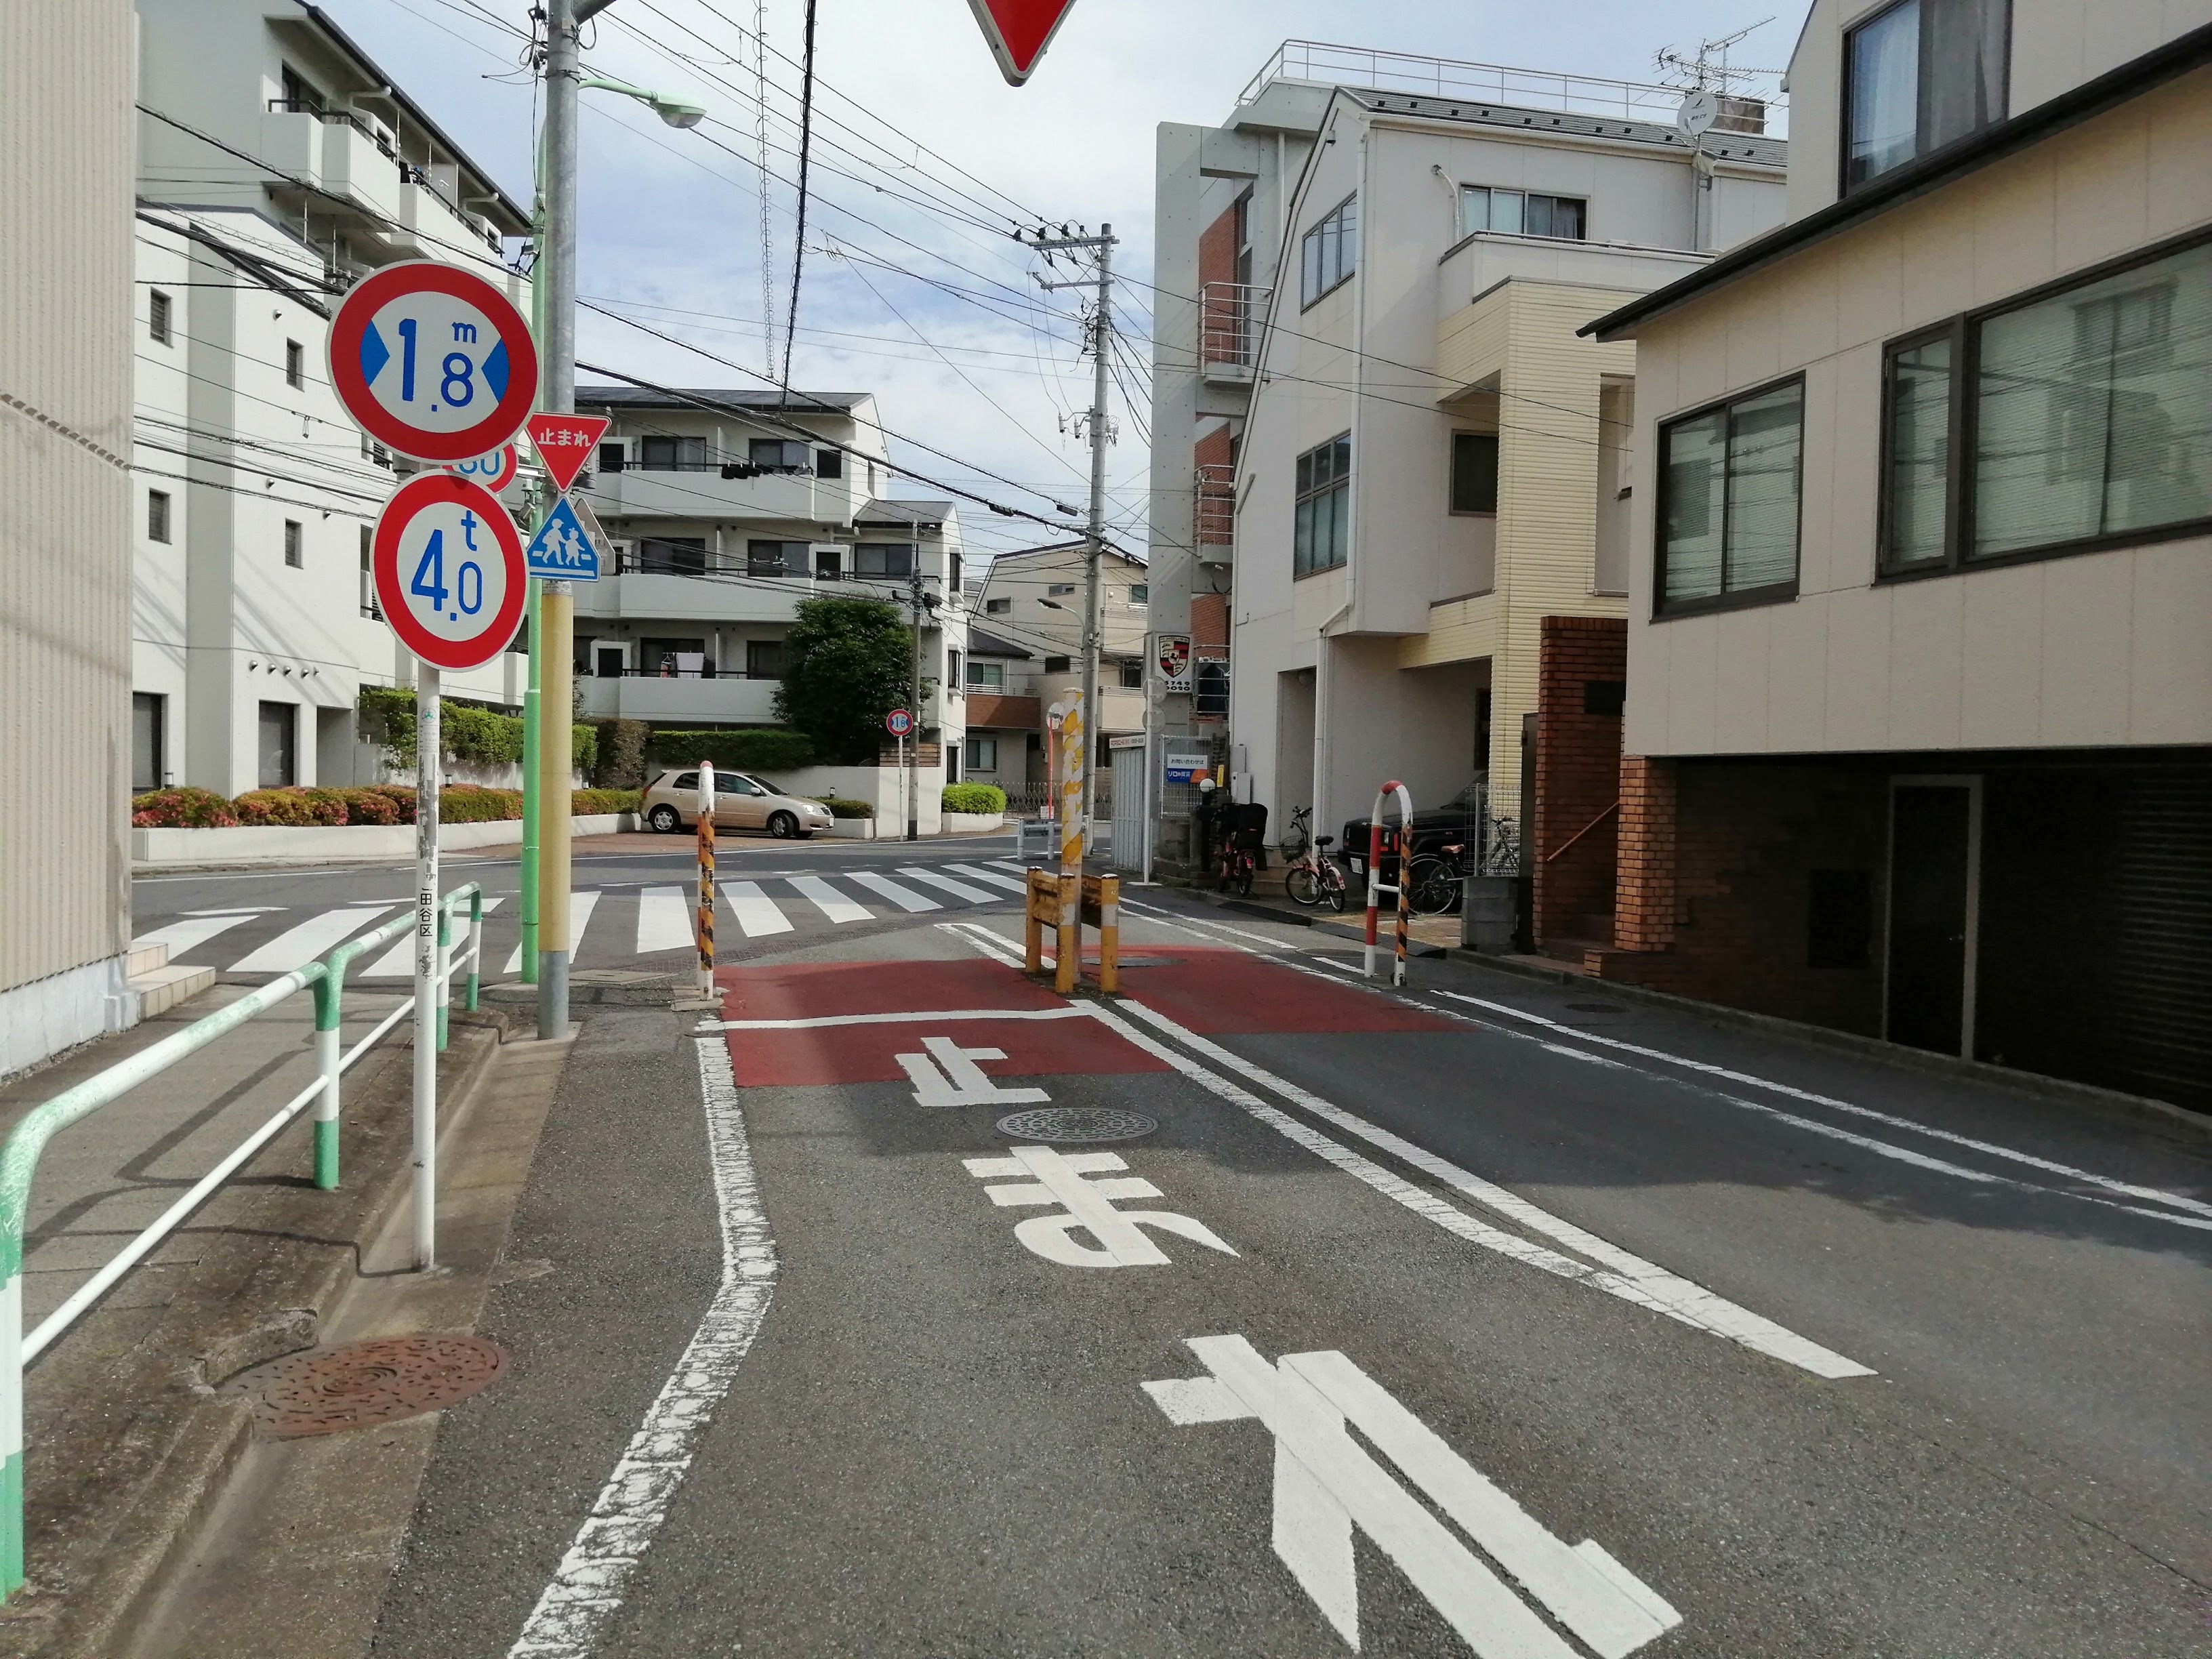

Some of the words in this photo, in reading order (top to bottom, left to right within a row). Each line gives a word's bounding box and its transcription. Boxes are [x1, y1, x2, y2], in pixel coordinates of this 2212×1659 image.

[452, 321, 477, 344] m
[398, 319, 474, 412] 1.8
[537, 428, 592, 447] 止まれ
[461, 510, 478, 552] t
[411, 529, 483, 621] 4.0
[419, 887, 433, 937] 田谷区
[893, 1037, 1683, 1659] 止まれ
